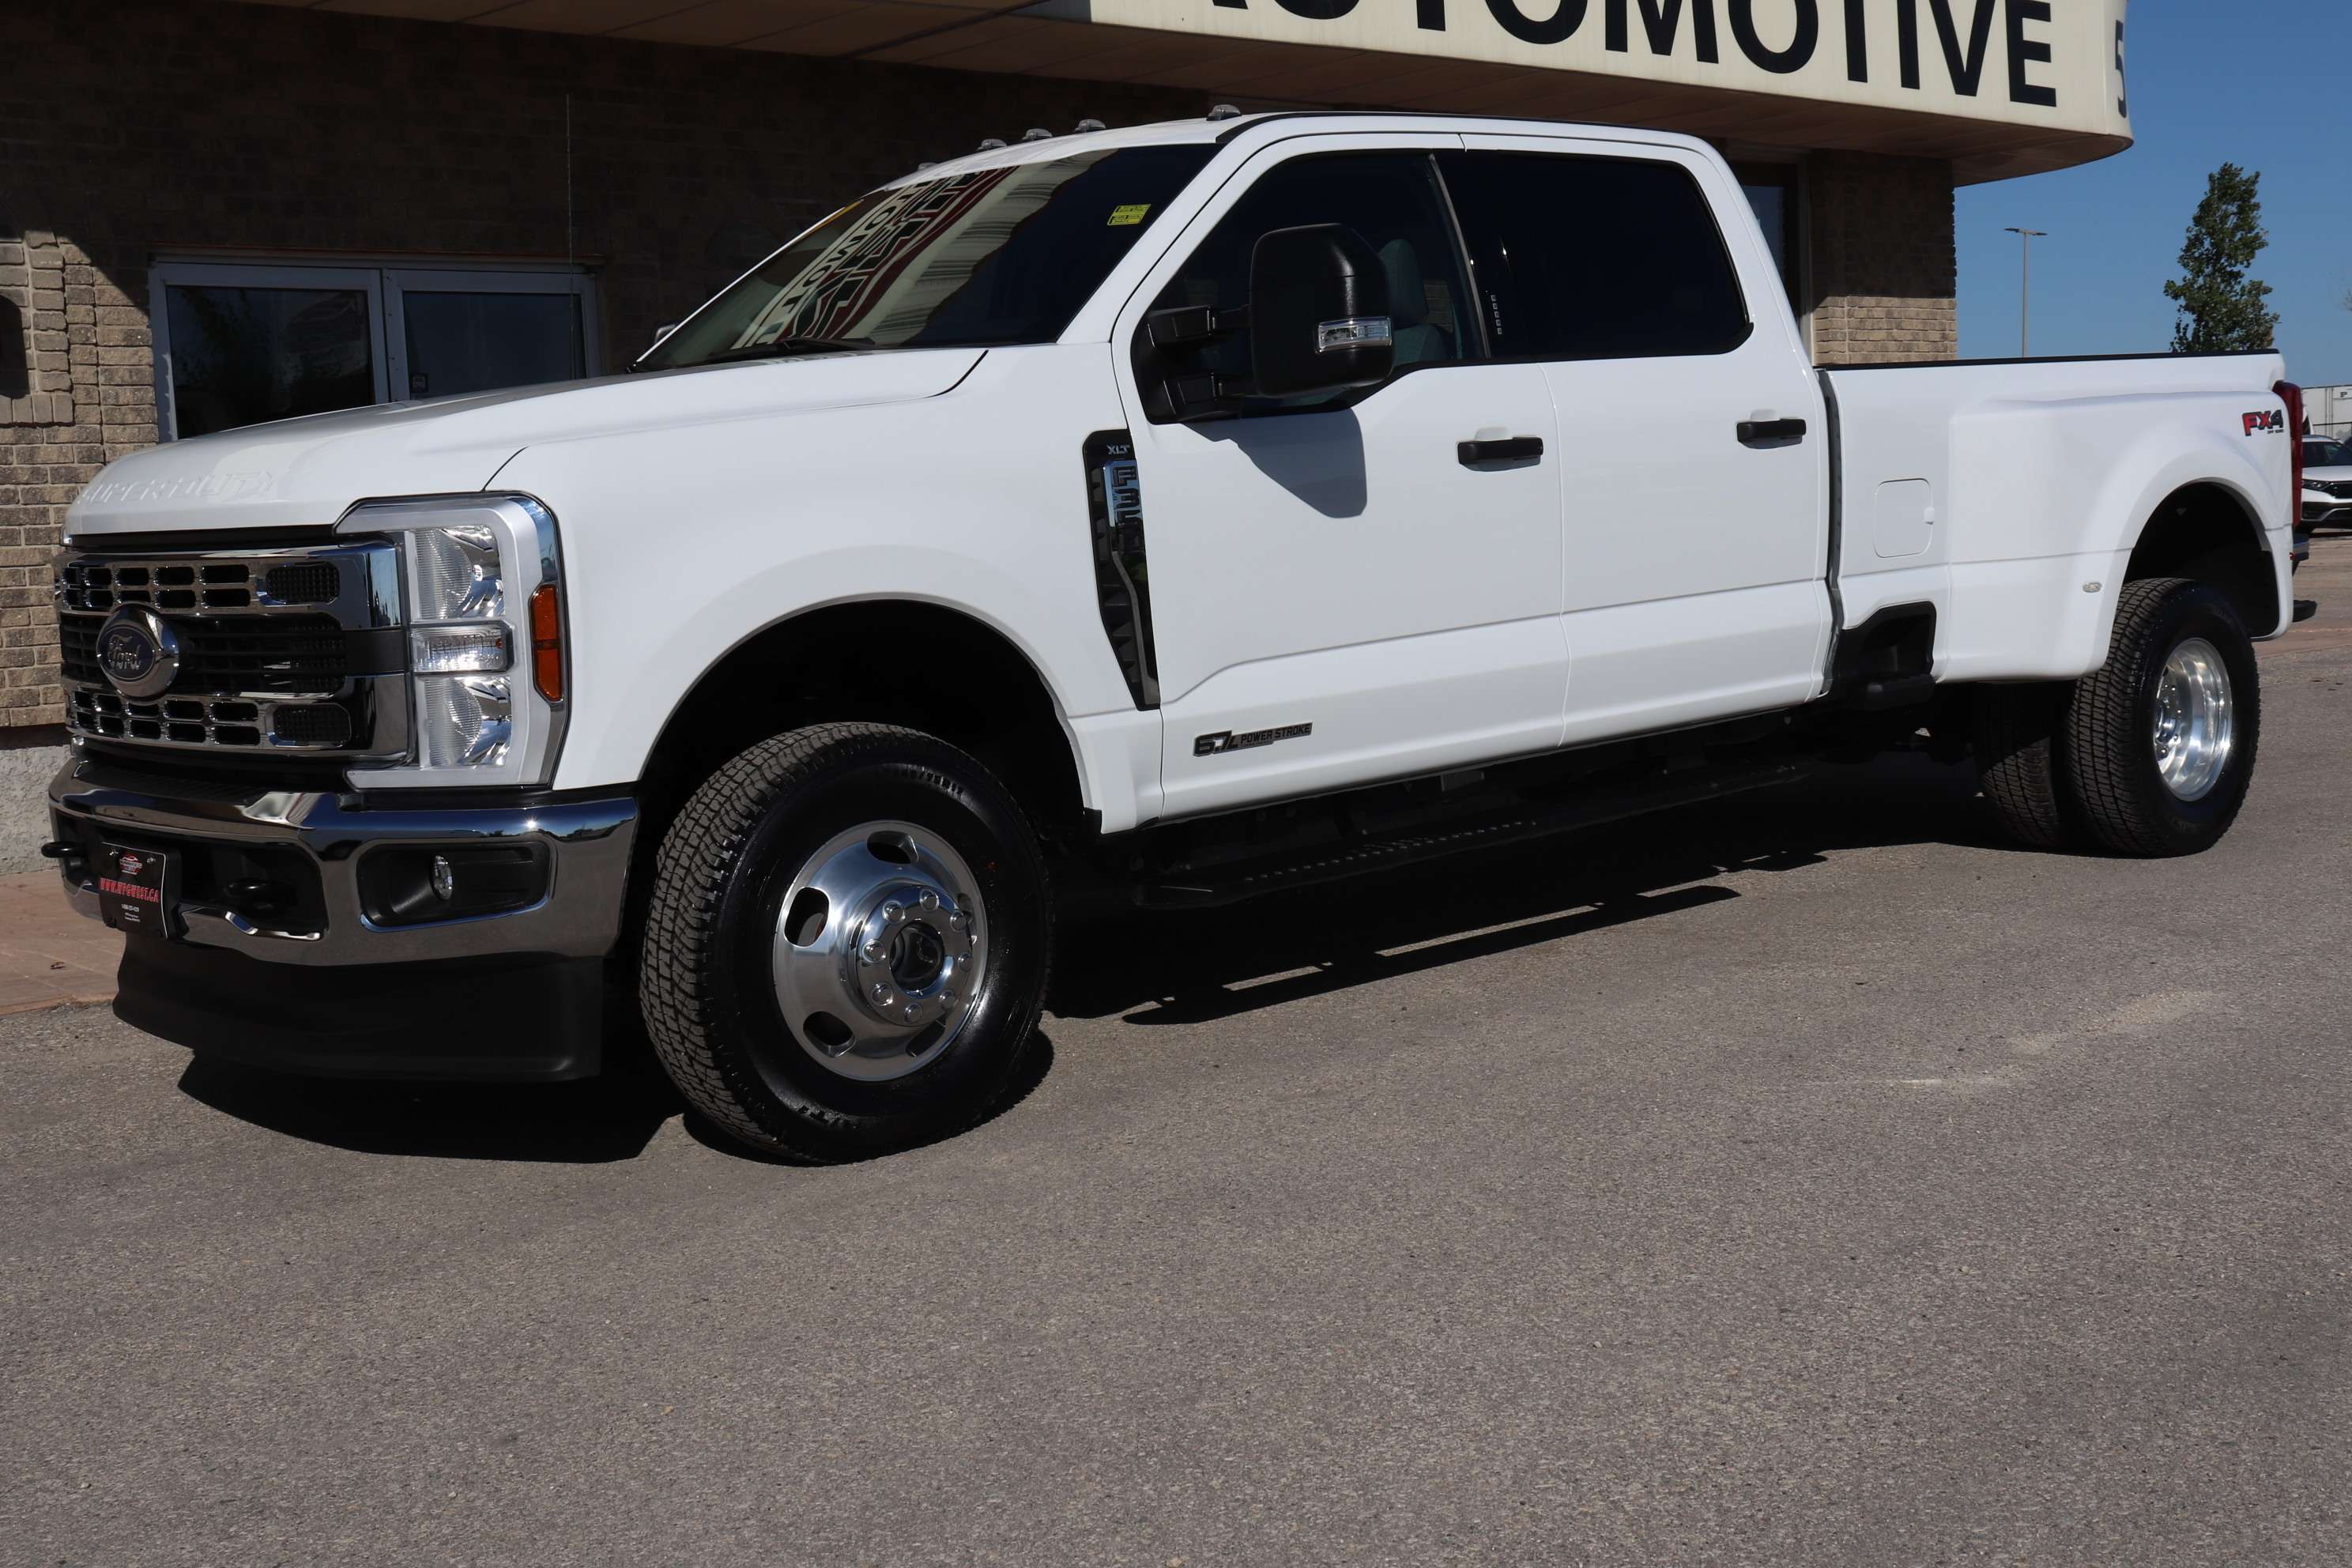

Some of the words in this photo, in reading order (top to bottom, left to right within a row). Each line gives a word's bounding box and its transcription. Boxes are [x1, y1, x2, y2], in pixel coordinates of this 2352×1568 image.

[2242, 409, 2283, 436] FX4
[1106, 444, 1130, 454] XLT
[107, 635, 141, 670] Ford
[1241, 730, 1272, 744] POWER
[1275, 723, 1311, 738] STROKE
